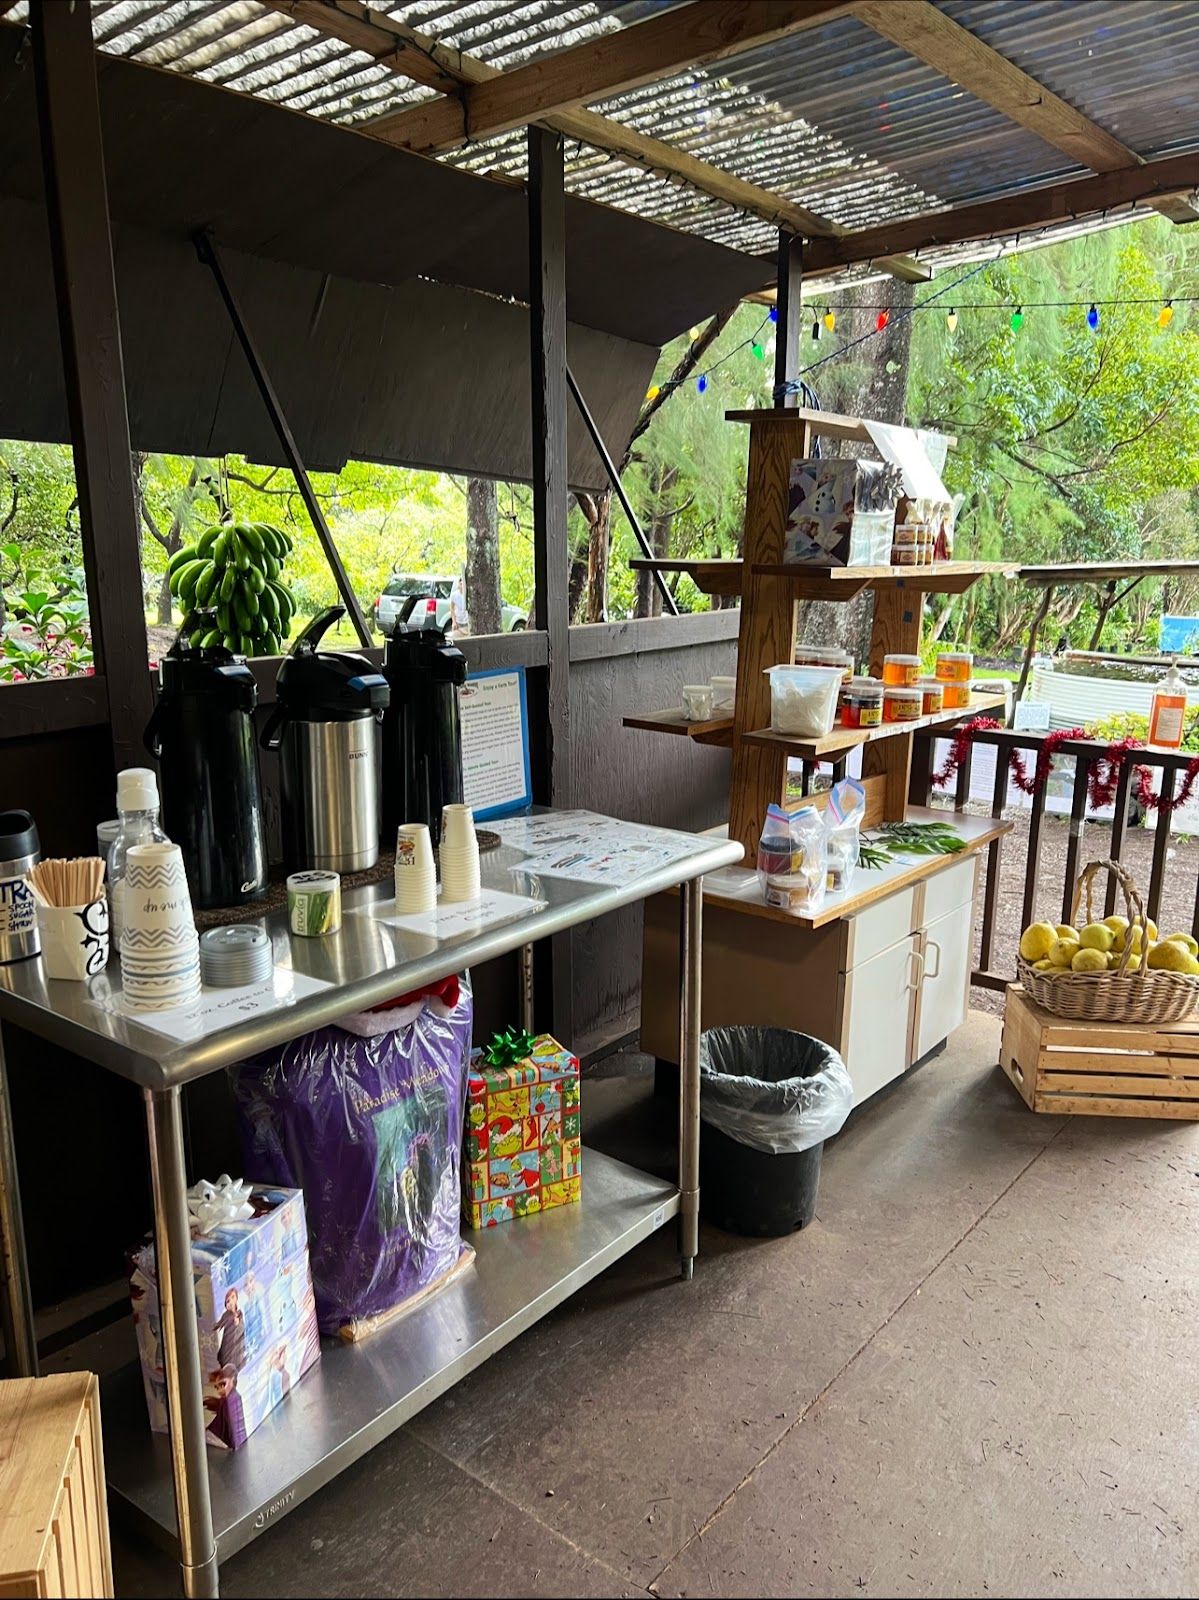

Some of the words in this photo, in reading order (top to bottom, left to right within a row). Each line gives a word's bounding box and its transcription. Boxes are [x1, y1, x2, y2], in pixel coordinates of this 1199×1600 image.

[7, 900, 34, 913] SPOON
[142, 897, 158, 914] up
[8, 909, 35, 921] SUGAR
[217, 994, 252, 1009] Coffee
[353, 1087, 401, 1116] Paradise
[265, 1489, 296, 1519] TRINITY
